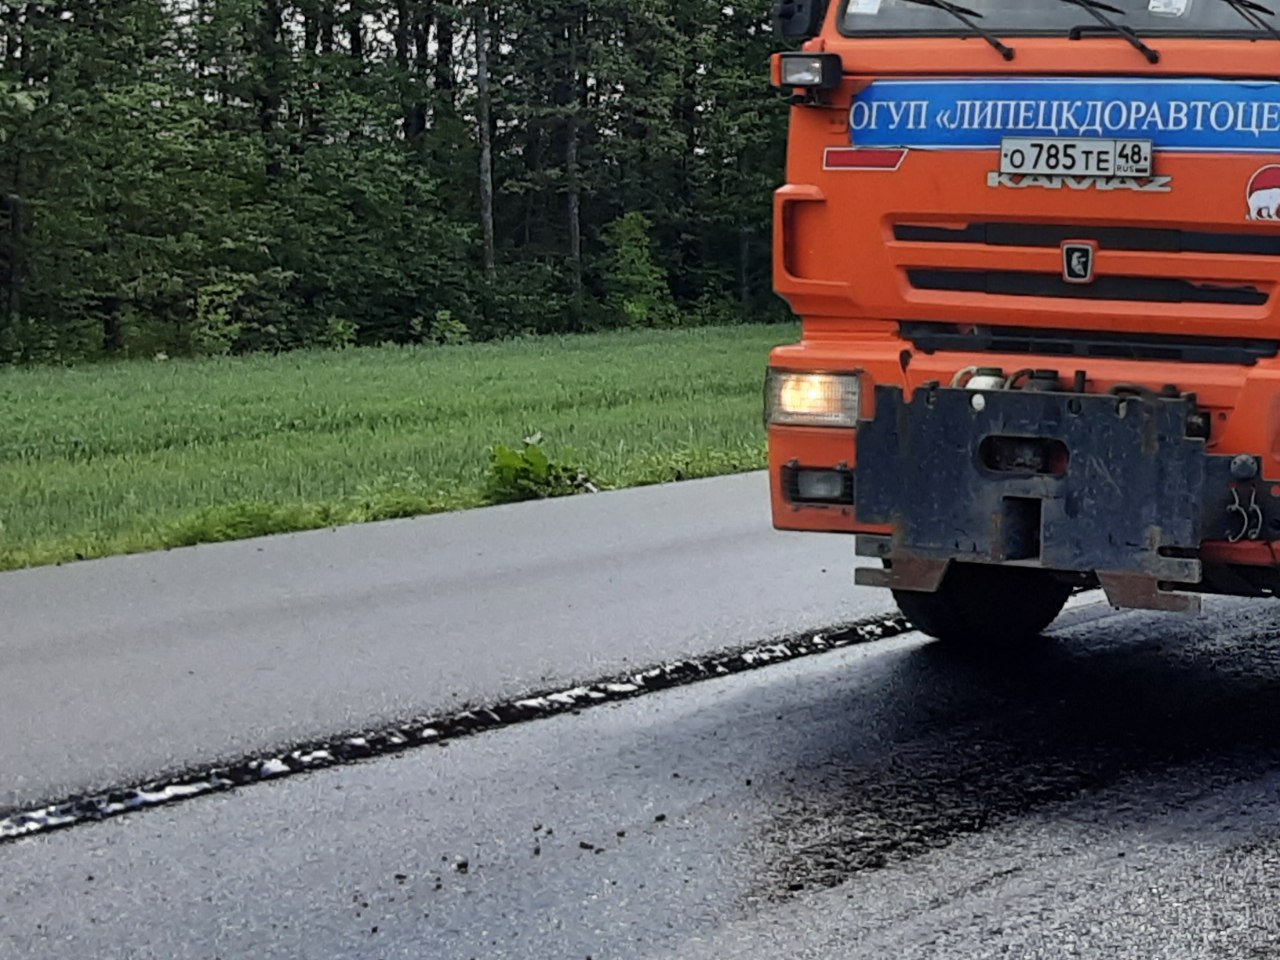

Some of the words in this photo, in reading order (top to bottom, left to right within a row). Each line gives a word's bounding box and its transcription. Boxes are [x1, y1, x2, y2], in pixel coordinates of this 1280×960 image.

[849, 101, 930, 130] ОГУП
[1117, 143, 1142, 164] 48
[1116, 165, 1135, 173] RUS
